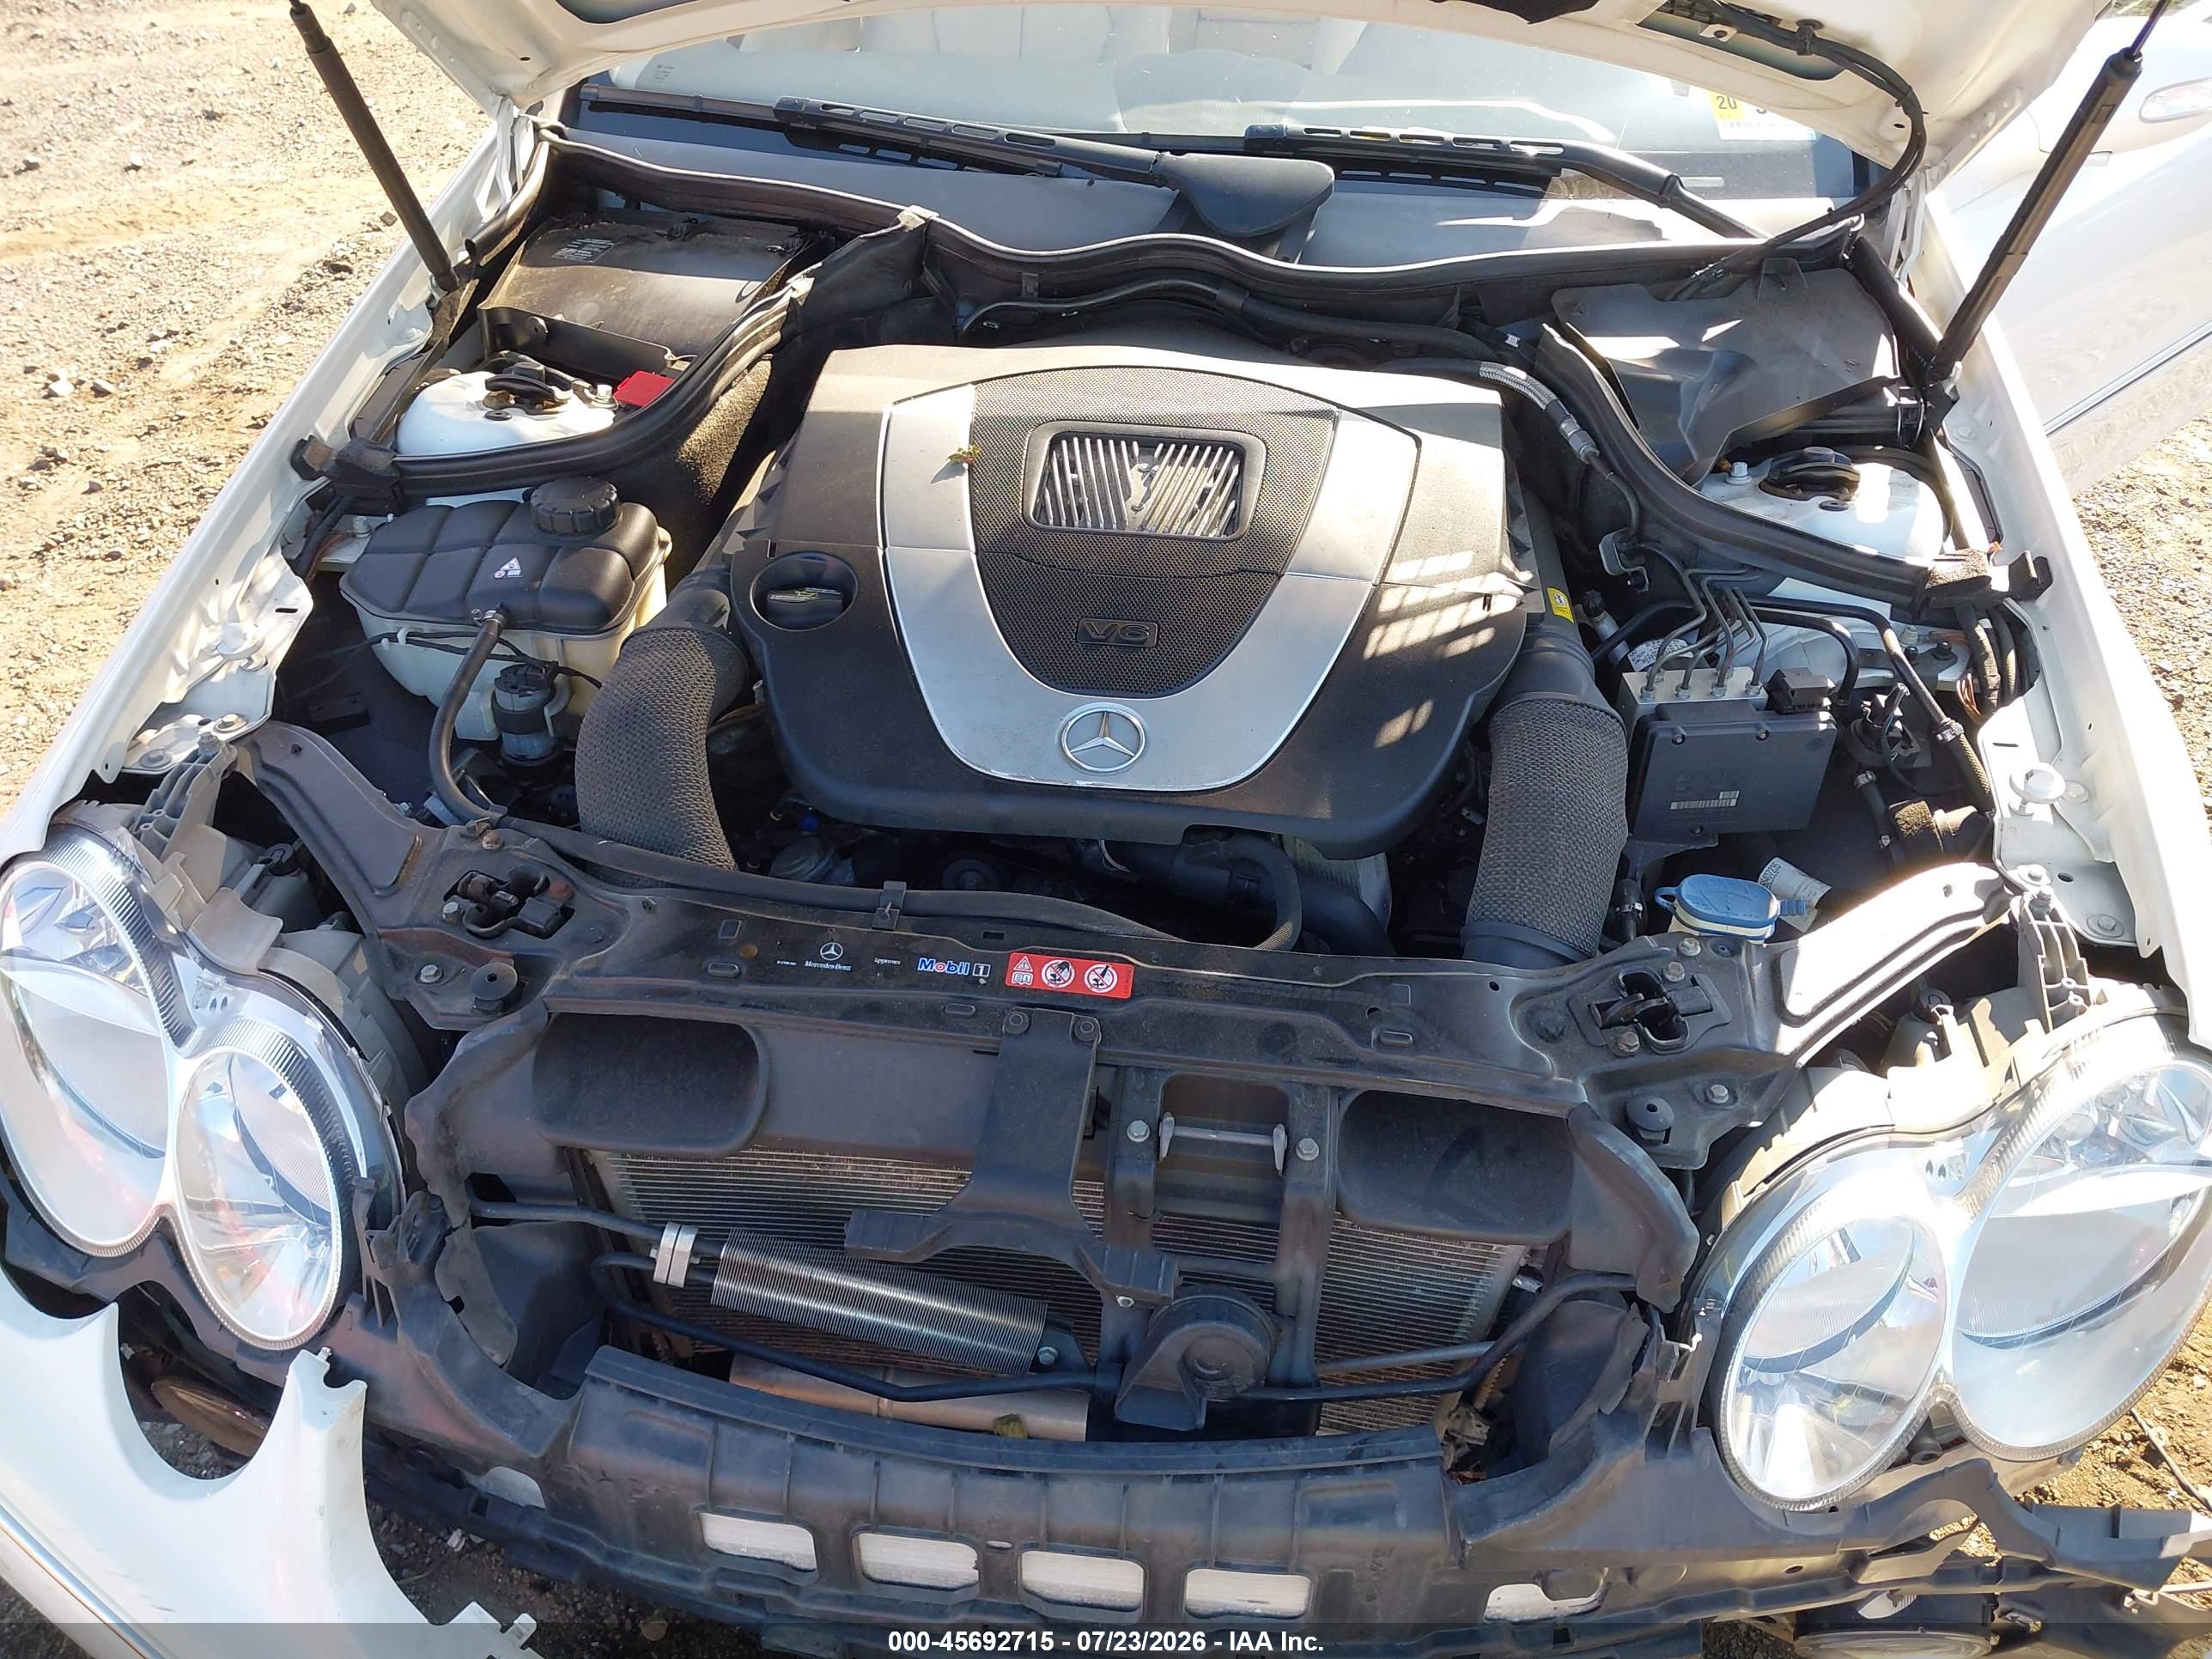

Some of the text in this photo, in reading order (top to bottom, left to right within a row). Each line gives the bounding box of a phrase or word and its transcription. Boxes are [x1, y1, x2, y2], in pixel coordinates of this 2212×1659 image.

[1084, 622, 1150, 641] V6
[804, 960, 852, 971] Mercedes-Benz
[917, 957, 970, 975] Mobil
